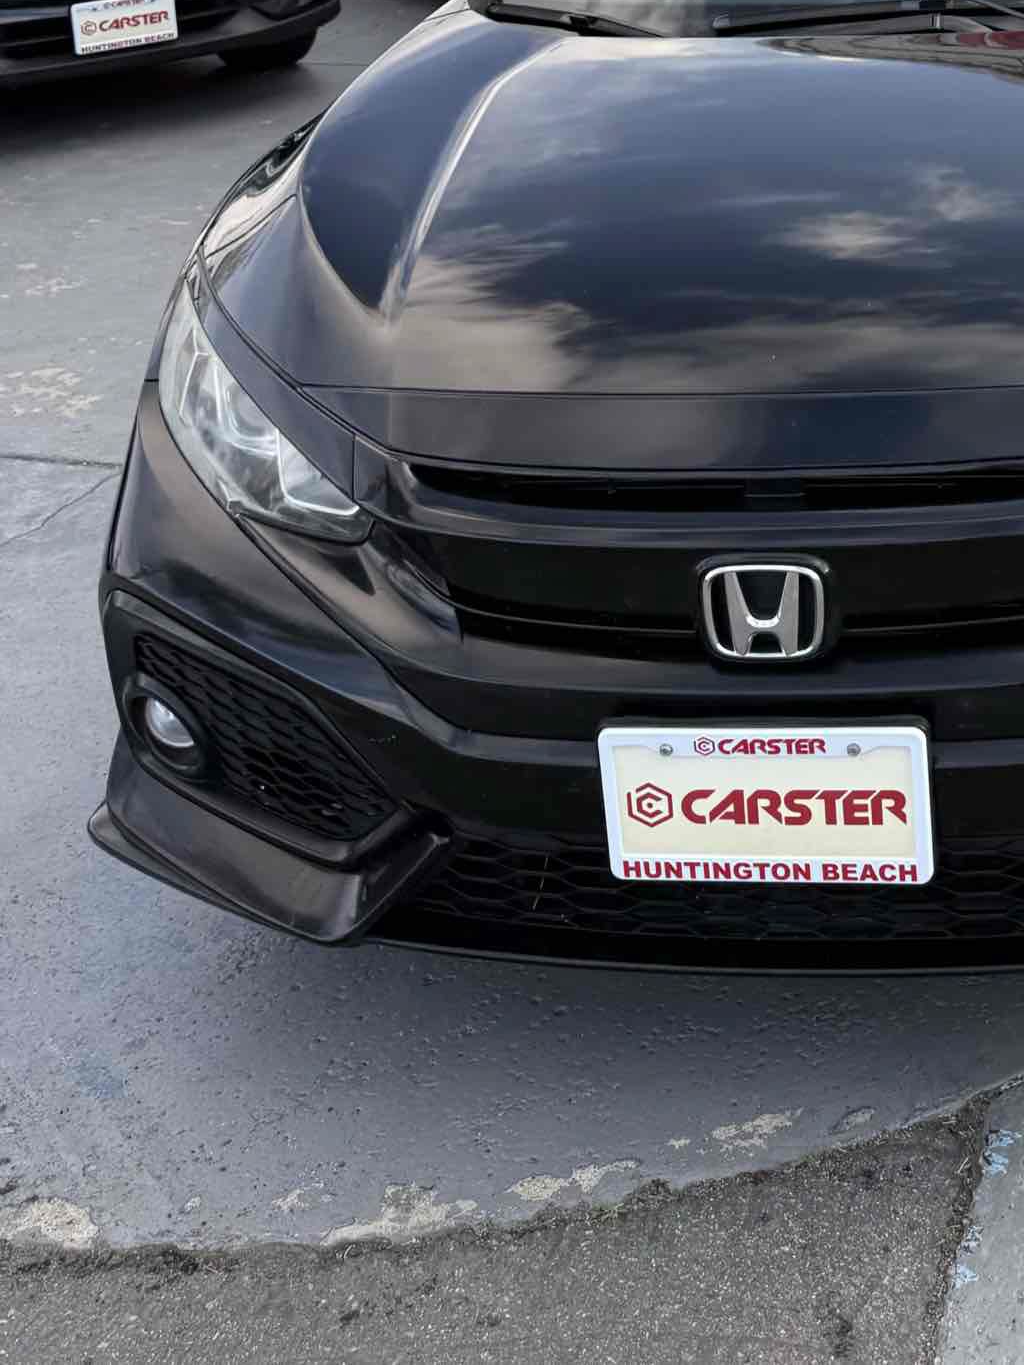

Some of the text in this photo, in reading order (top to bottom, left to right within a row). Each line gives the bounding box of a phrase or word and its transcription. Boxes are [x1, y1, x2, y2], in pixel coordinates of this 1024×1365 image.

[99, 10, 168, 32] CARSTER
[81, 33, 175, 53] HUNTINGTON BEACH
[718, 738, 827, 755] CARSTER
[681, 788, 908, 827] CARSTER
[622, 860, 919, 883] HUNTINGTON BEACH
